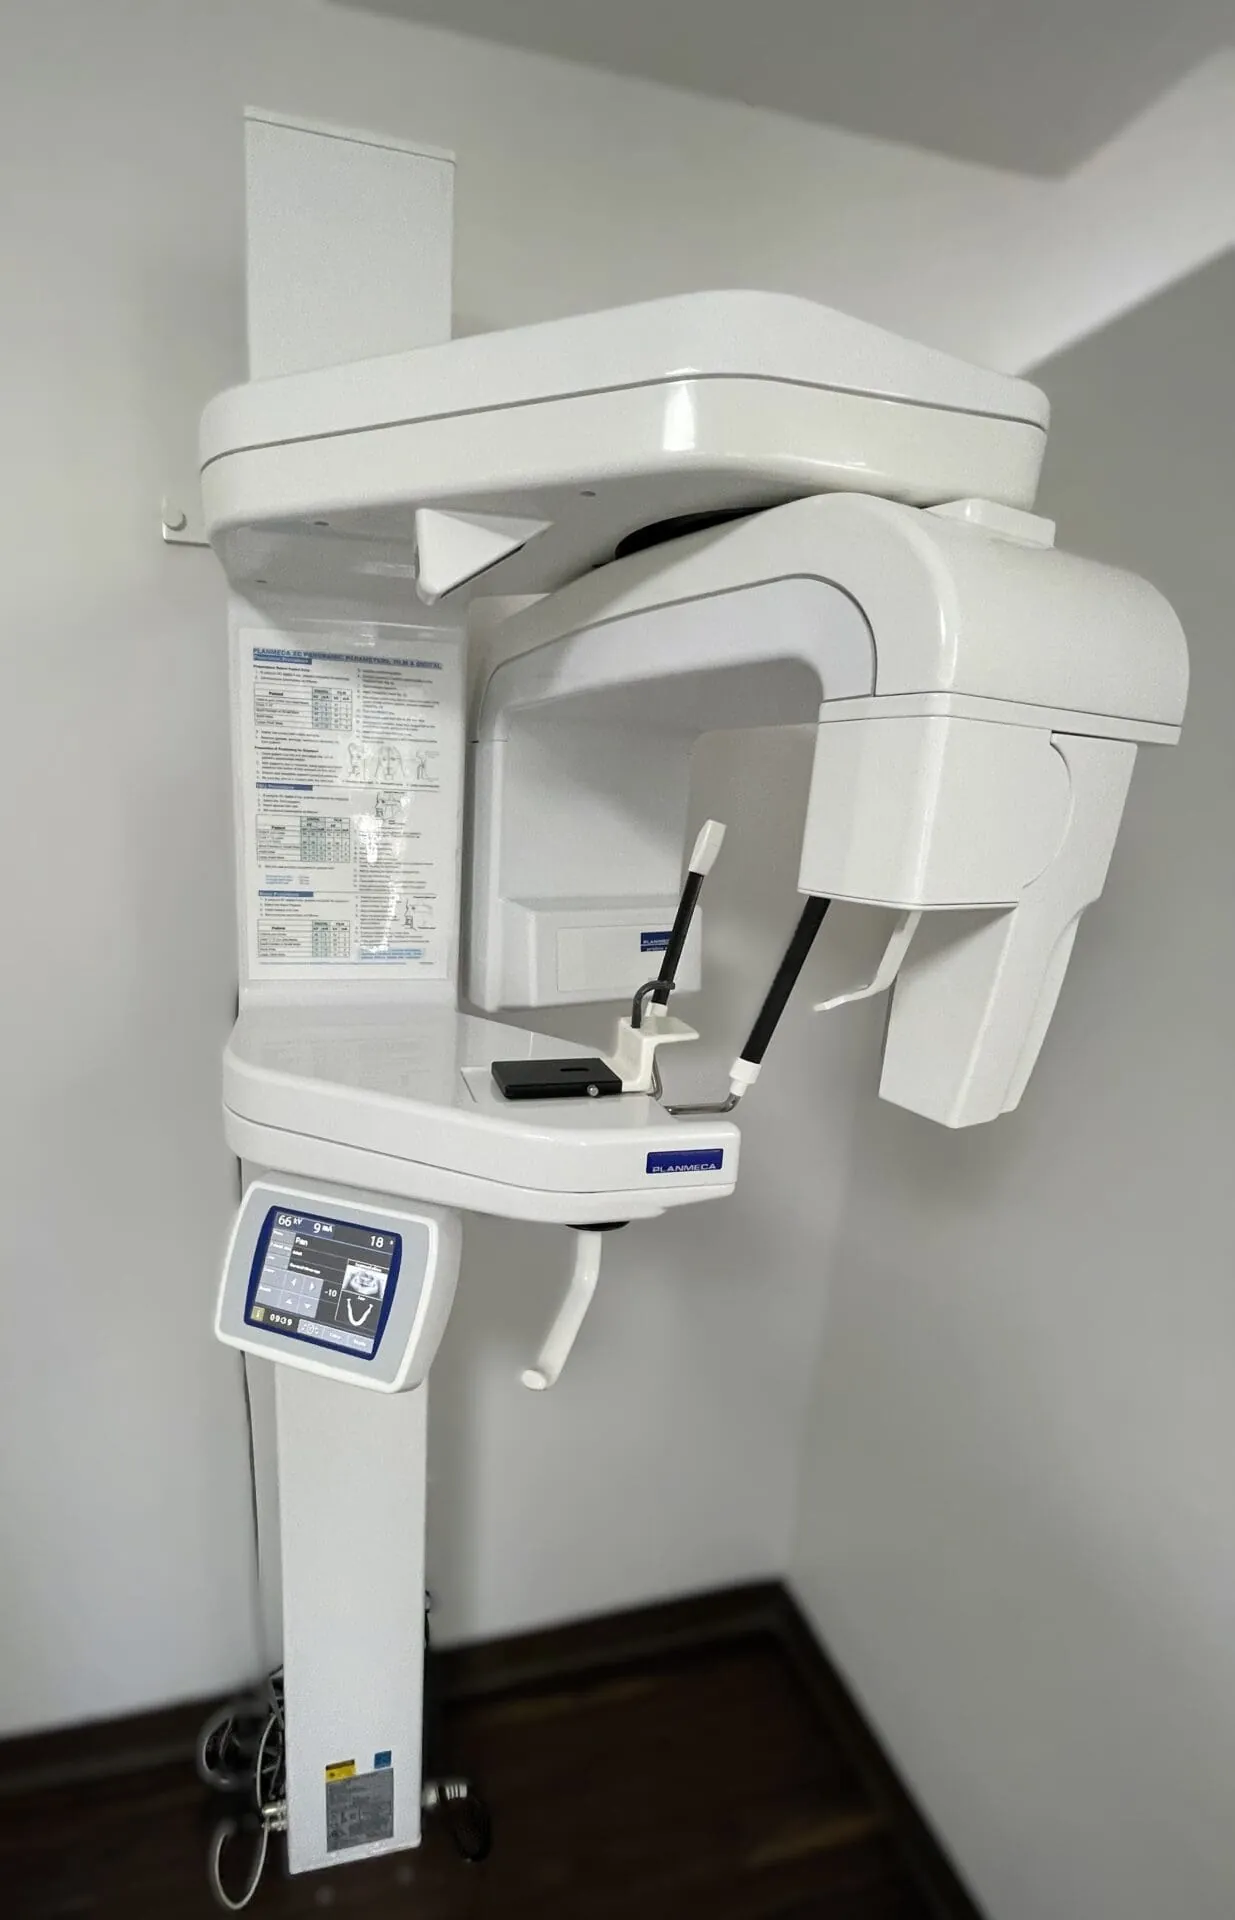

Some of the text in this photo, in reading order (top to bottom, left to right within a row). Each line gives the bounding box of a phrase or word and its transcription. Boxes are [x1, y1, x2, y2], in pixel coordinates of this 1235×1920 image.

[652, 1163, 717, 1173] PLANMECA
[278, 1215, 292, 1227] 66
[313, 1222, 321, 1234] 9
[370, 1235, 384, 1248] 18
[324, 1288, 338, 1298] -10
